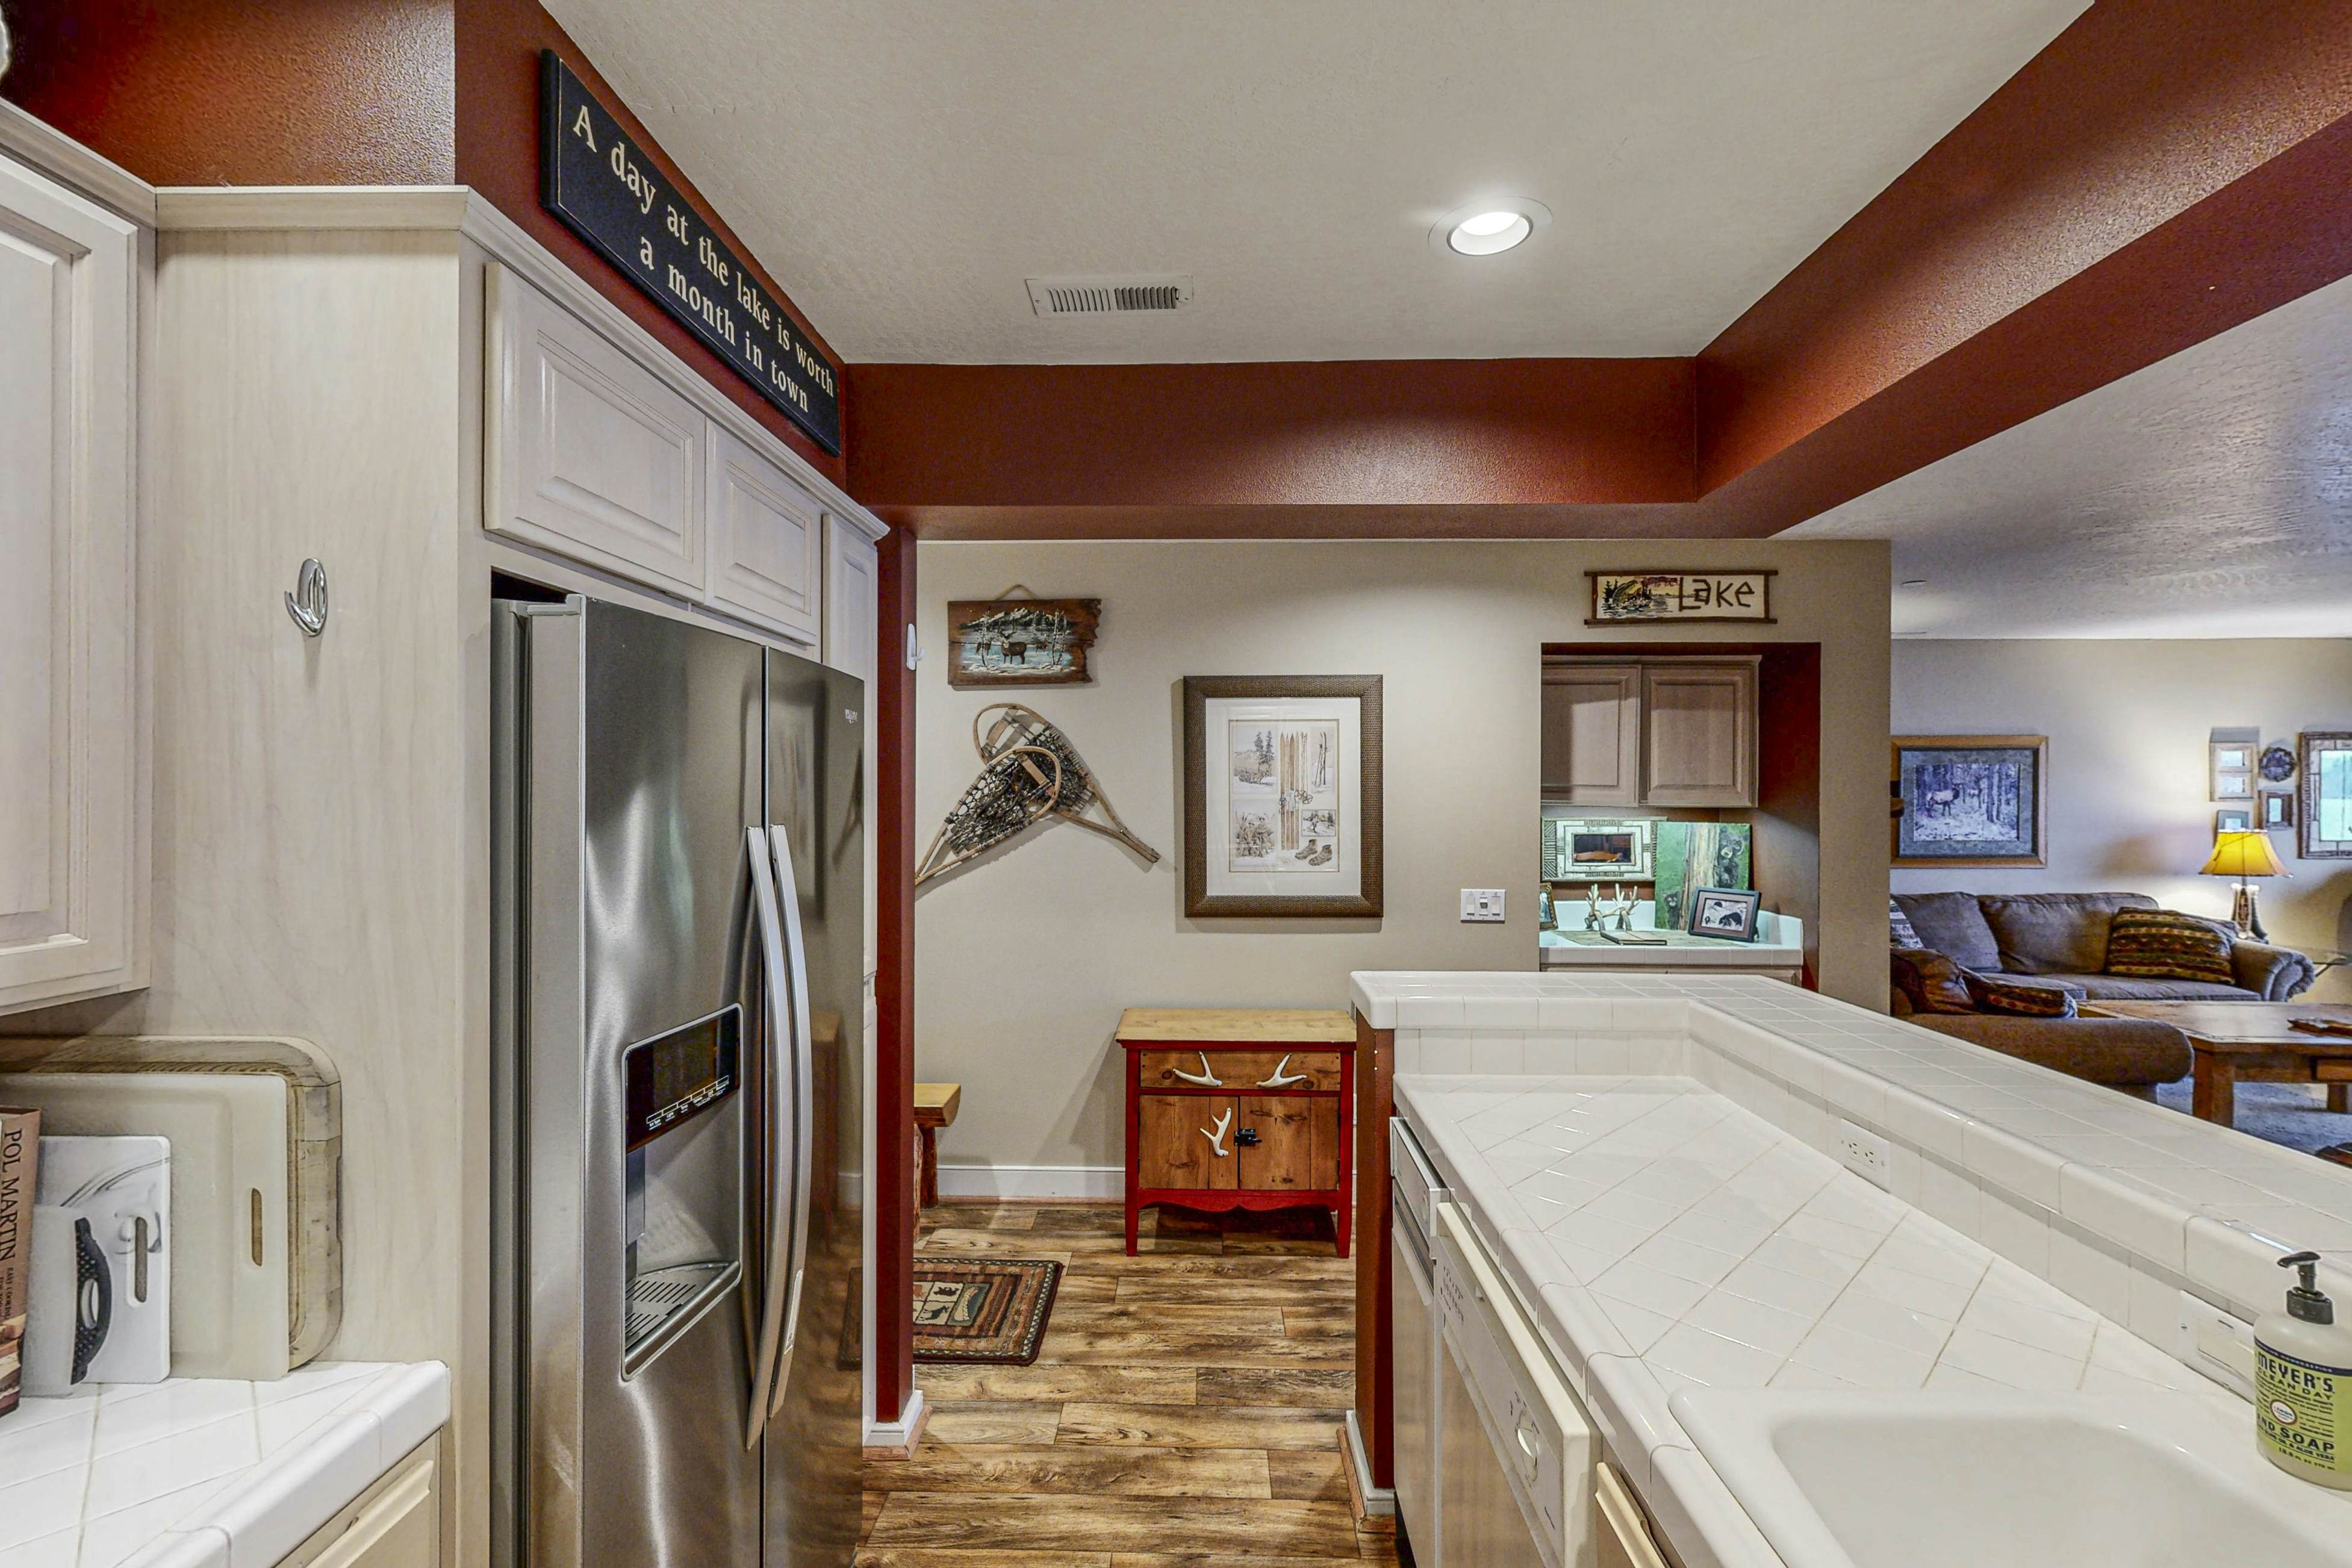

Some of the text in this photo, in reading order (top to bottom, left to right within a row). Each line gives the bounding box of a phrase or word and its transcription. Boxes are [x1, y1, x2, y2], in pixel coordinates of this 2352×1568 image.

[573, 105, 833, 397] A day at the lake is worth
[640, 236, 808, 412] a month in town
[0, 1127, 22, 1262] POL MARTIN
[2257, 1351, 2334, 1393] MEYER'S
[2280, 1427, 2335, 1452] SOAP
